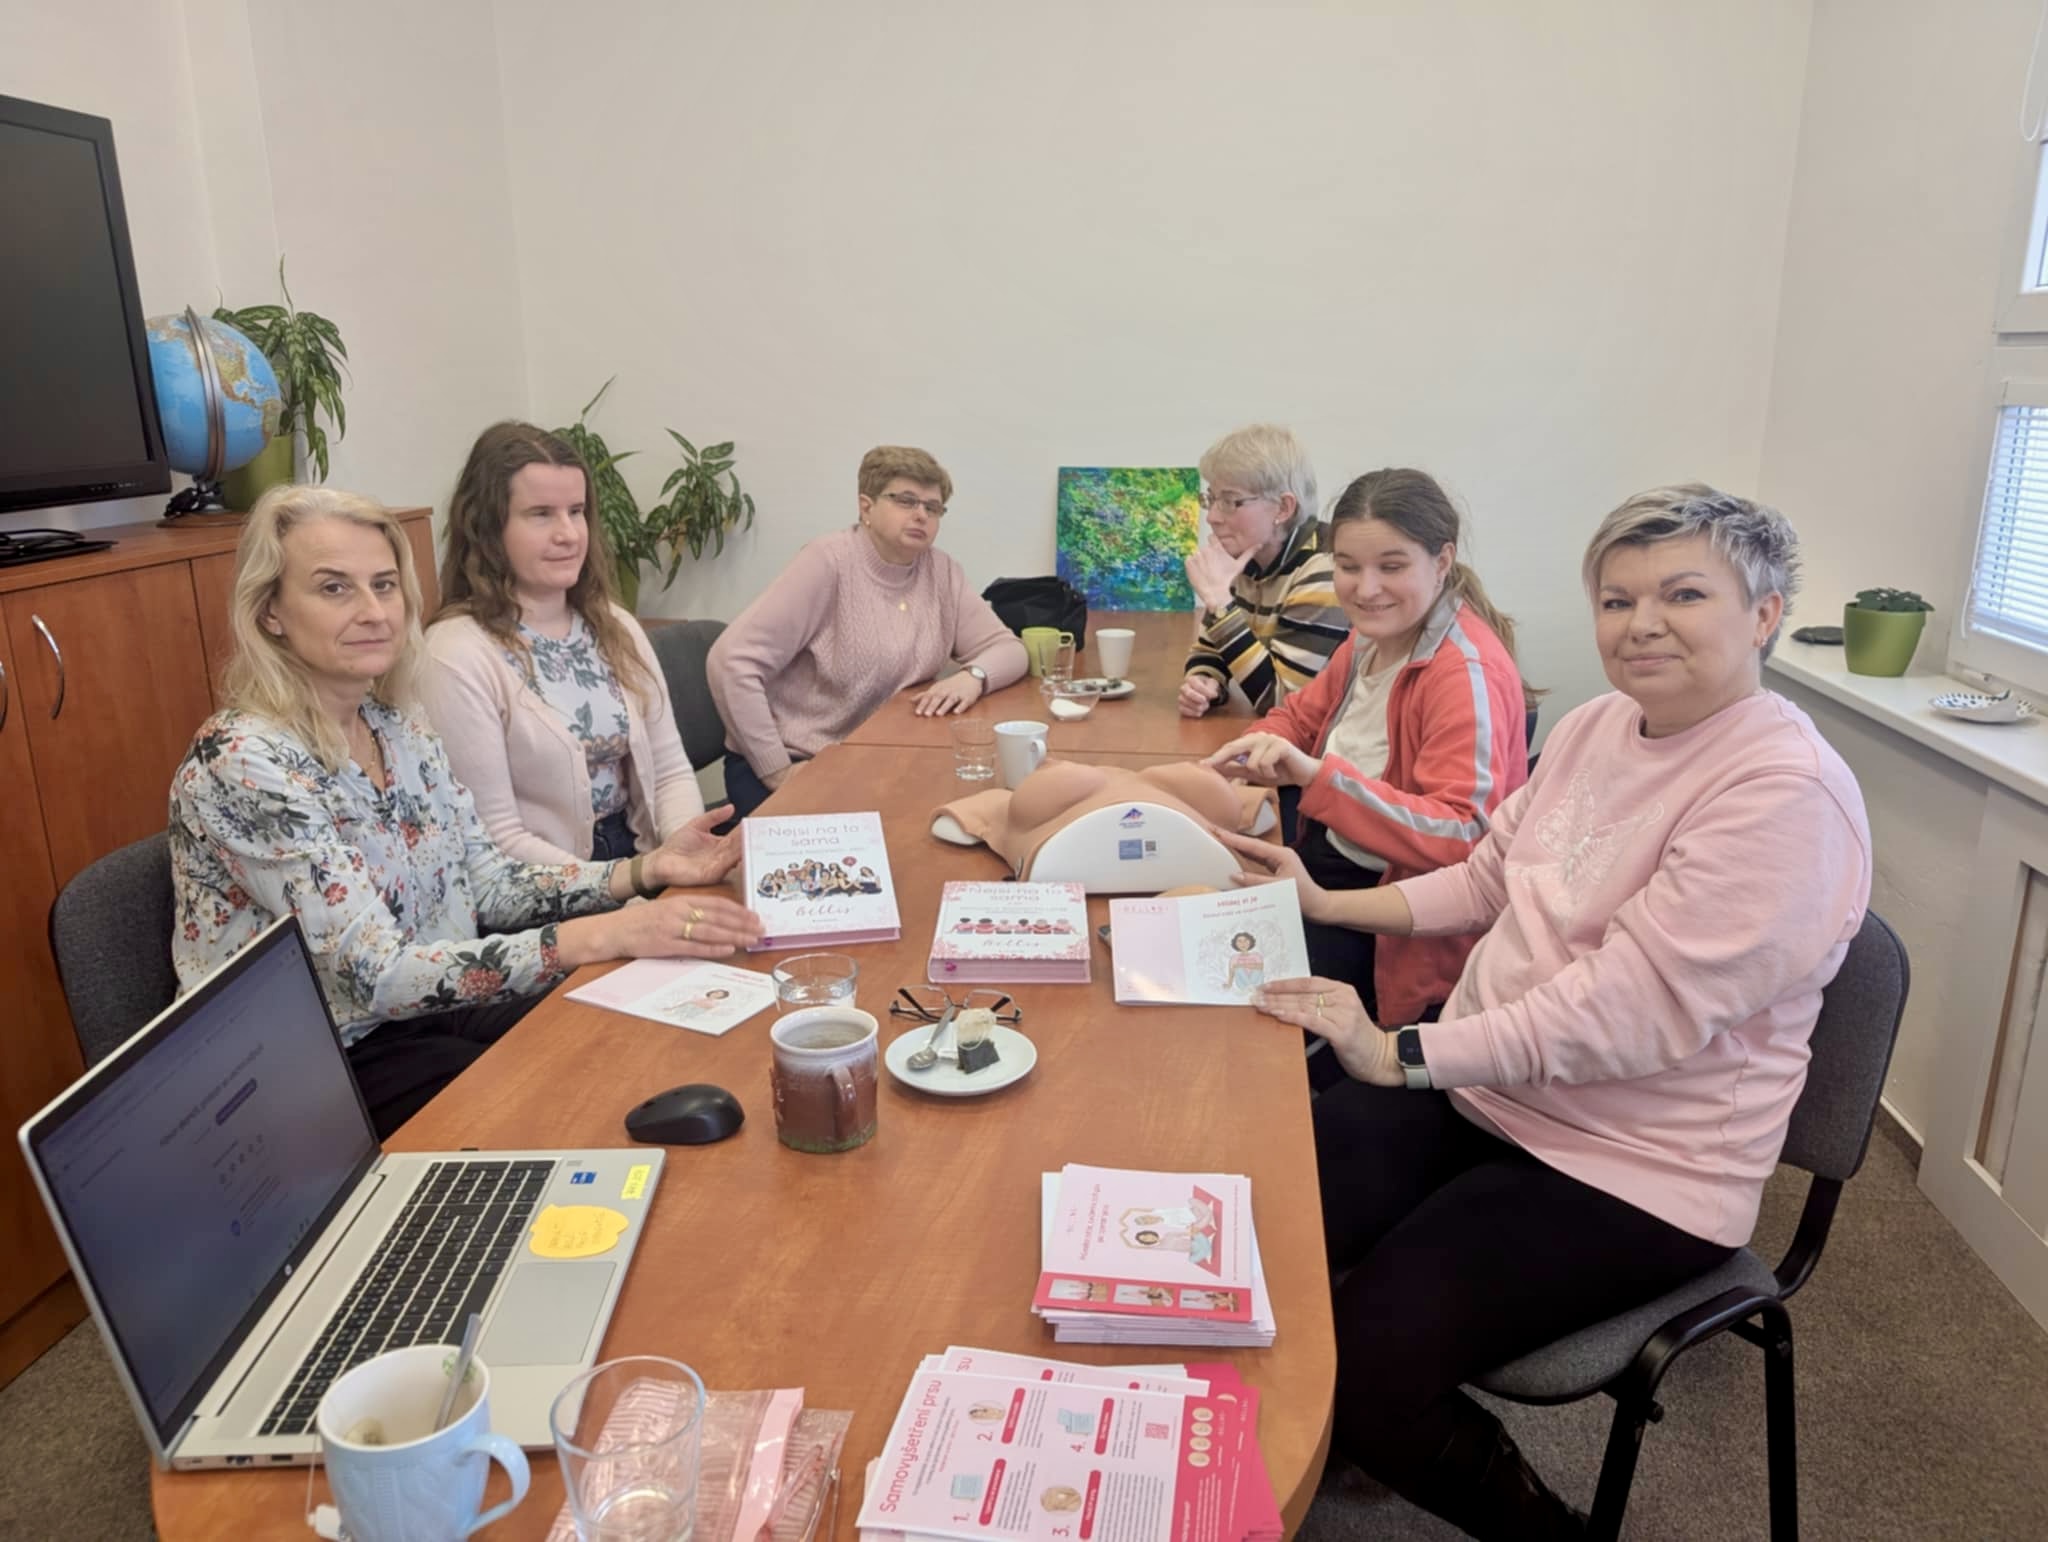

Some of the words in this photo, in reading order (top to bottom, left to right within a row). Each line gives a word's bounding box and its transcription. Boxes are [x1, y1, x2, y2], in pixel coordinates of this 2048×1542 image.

[768, 826, 810, 837] Nejsi
[815, 826, 838, 835] na
[842, 823, 860, 833] to
[791, 836, 840, 847] sama
[880, 1408, 931, 1512] Samovyšetření
[923, 1379, 942, 1407] prsu
